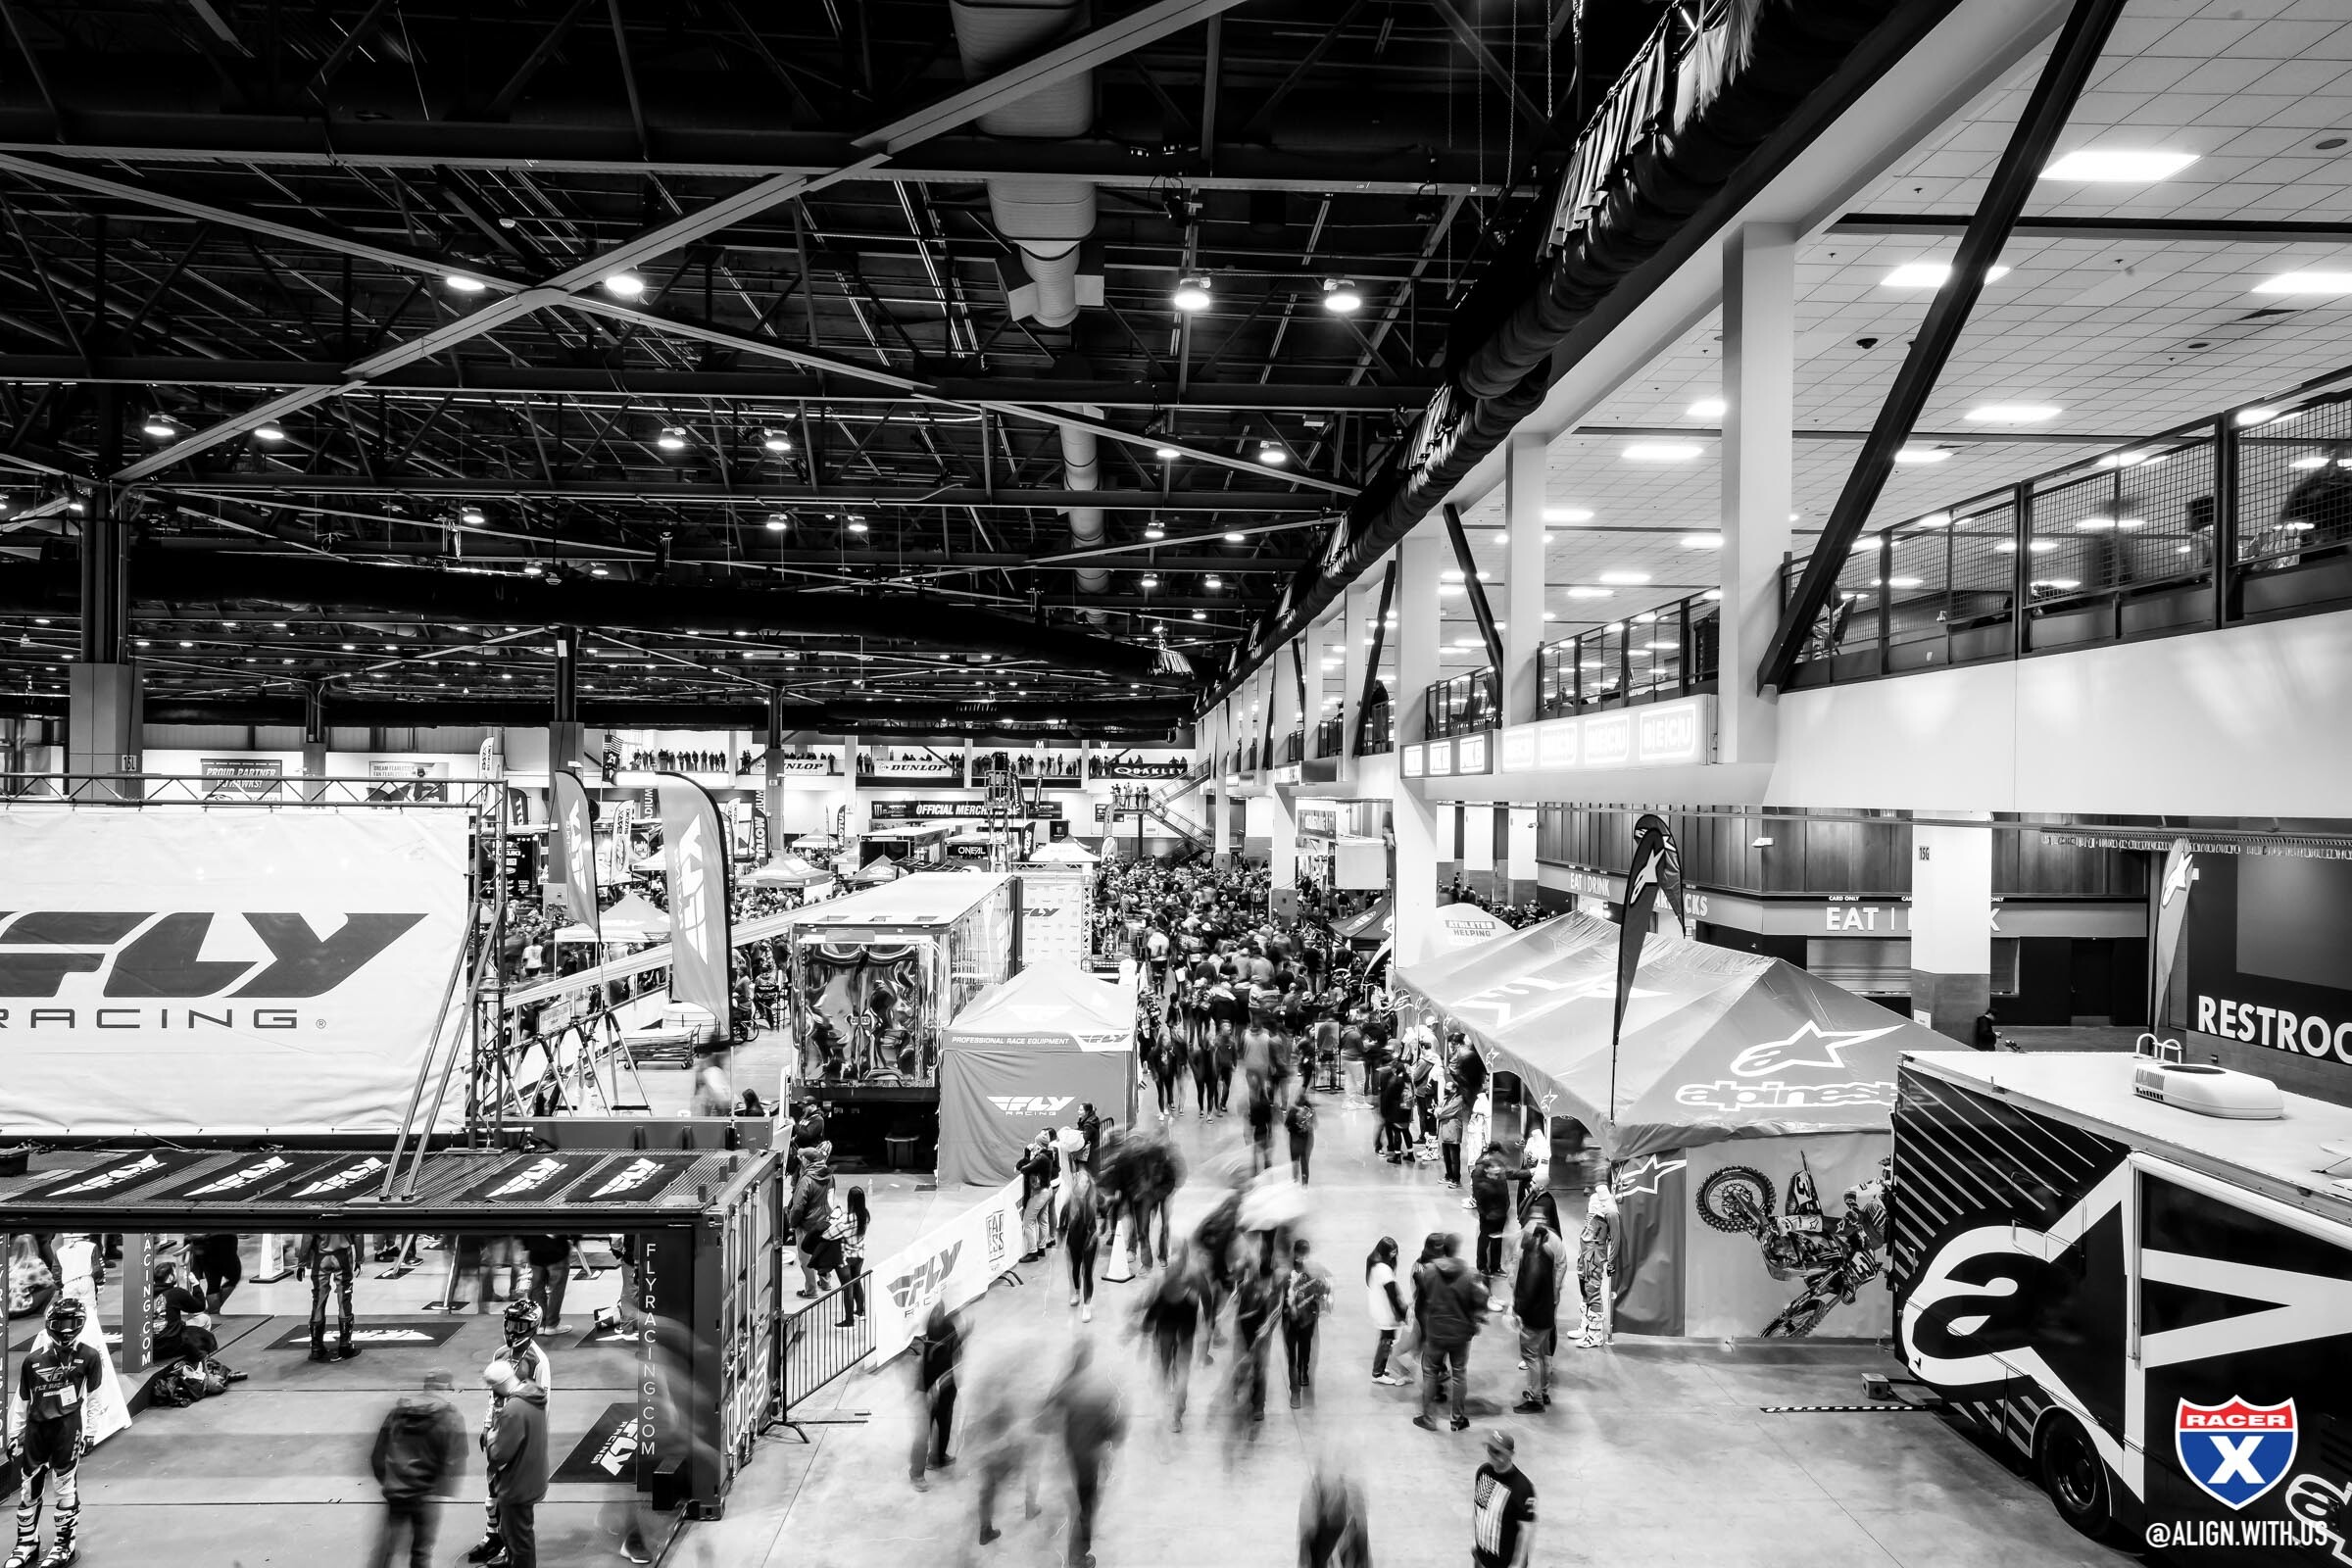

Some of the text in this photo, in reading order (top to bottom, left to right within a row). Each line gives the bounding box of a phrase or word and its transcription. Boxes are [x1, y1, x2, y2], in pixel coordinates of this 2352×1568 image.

[915, 805, 954, 815] OFFICIAL
[755, 815, 765, 859] MOTUL
[1919, 847, 1930, 860] 15G
[1570, 872, 1610, 898] EAT DRINK
[1826, 906, 1879, 931] EAT
[0, 911, 428, 998] FLY
[952, 1036, 1004, 1045] PROFESSIONAL
[1084, 1034, 1130, 1043] FLY
[995, 1096, 1076, 1111] FLY
[141, 1233, 153, 1366] ACING.COM
[641, 1243, 657, 1455] FLYRACING.COM
